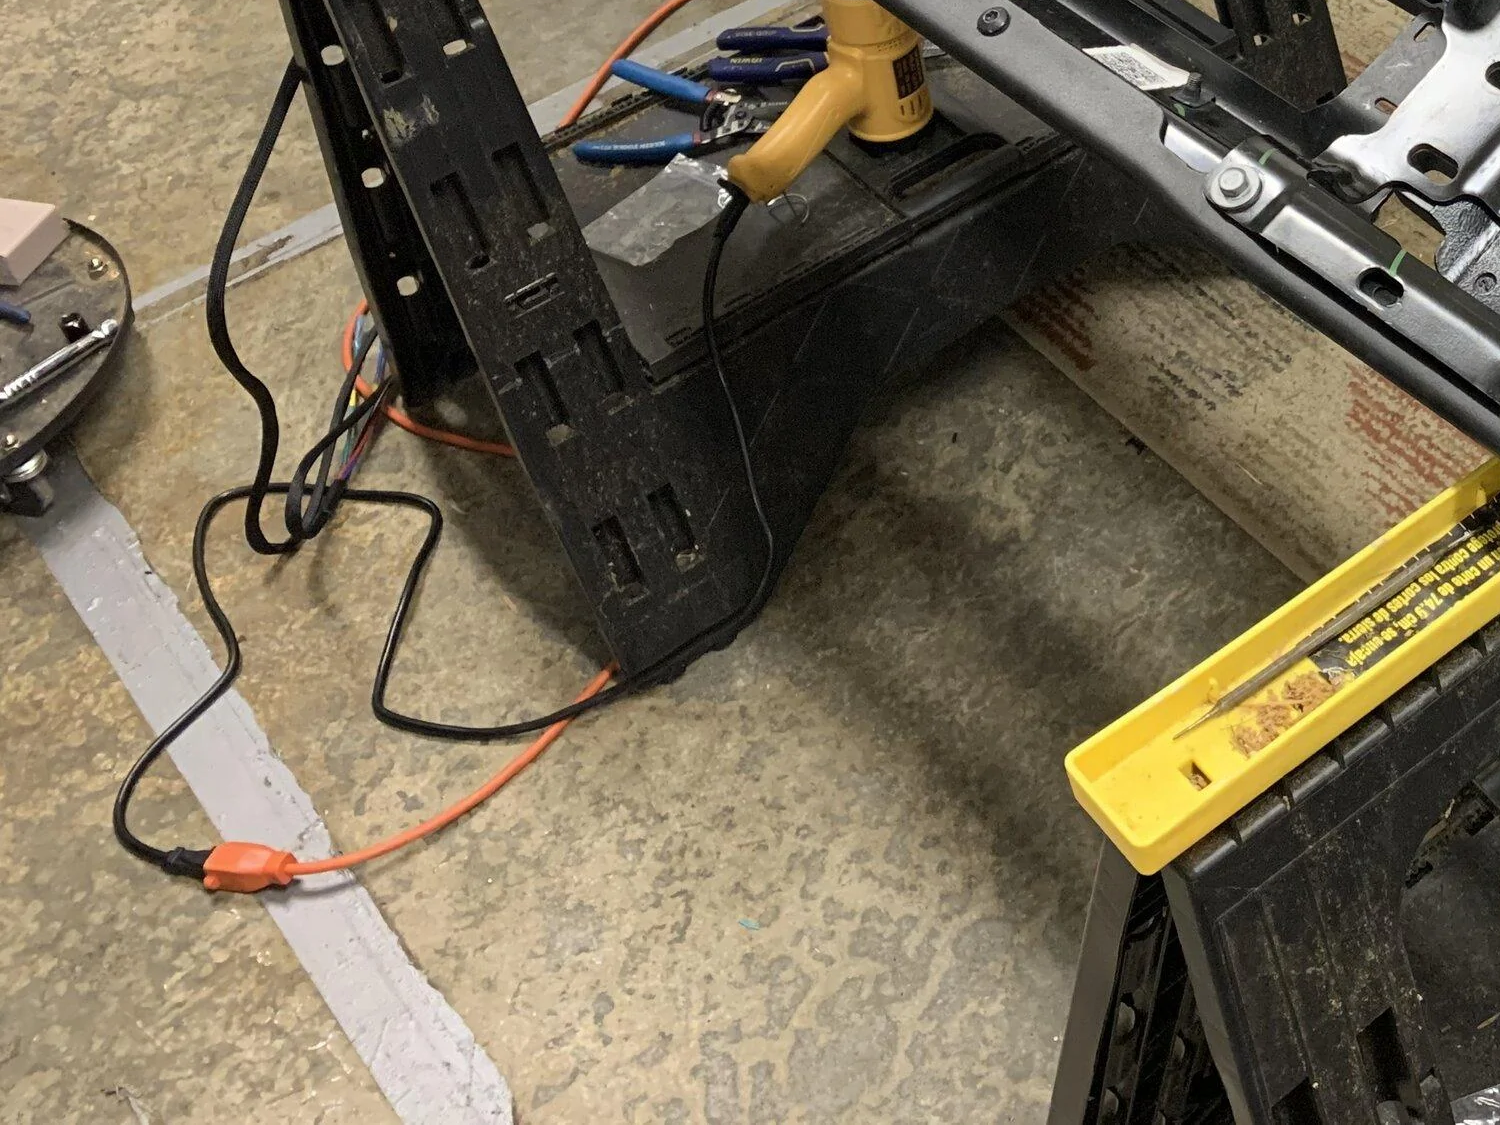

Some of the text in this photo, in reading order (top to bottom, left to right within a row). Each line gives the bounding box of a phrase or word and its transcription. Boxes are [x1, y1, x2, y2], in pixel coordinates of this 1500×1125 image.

[1434, 546, 1471, 579] contra
[1418, 569, 1440, 590] los
[1451, 562, 1481, 590] corte
[1385, 581, 1423, 614] cortes
[1436, 580, 1455, 600] de
[1372, 606, 1391, 625] de
